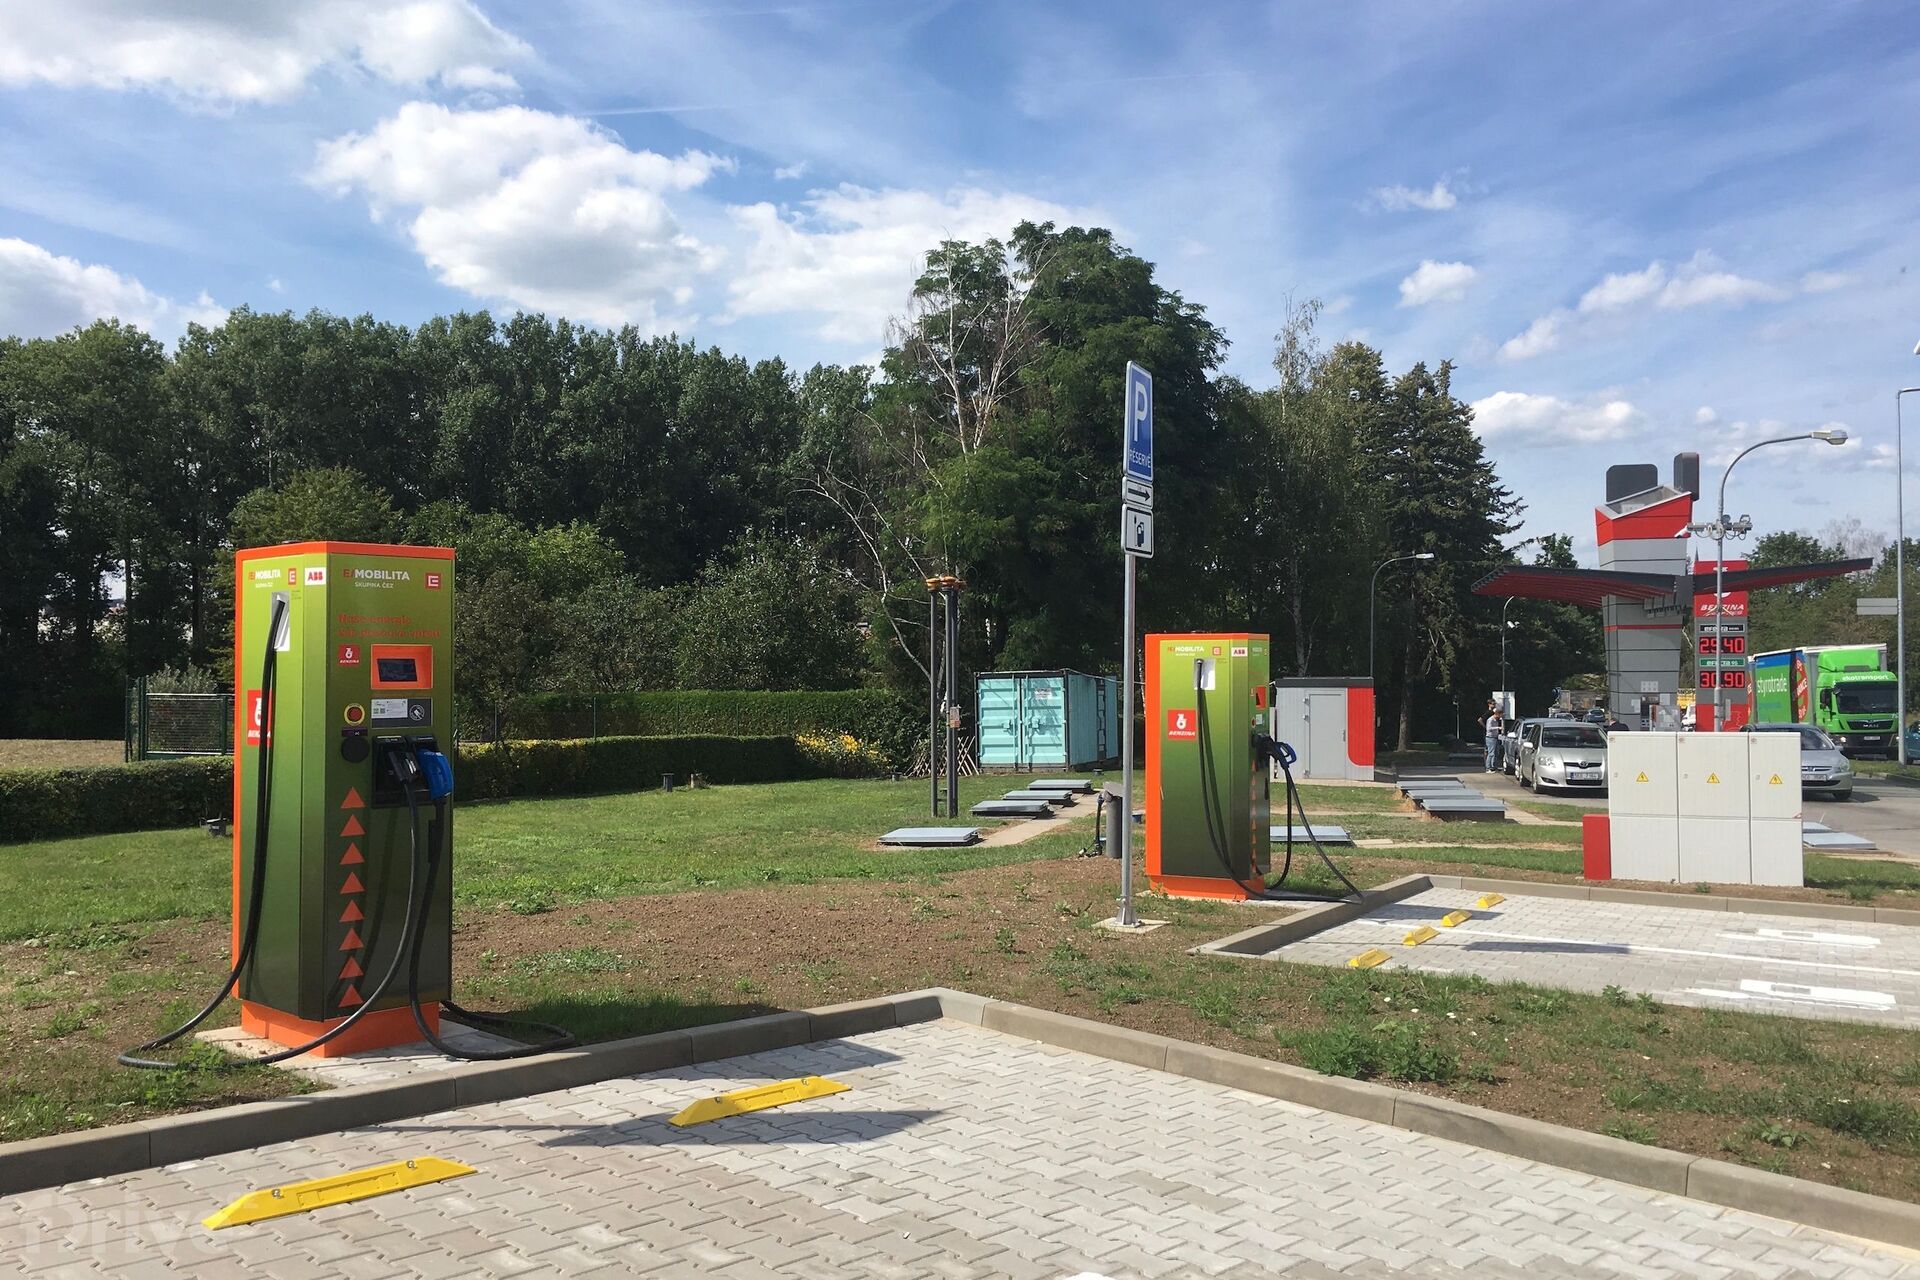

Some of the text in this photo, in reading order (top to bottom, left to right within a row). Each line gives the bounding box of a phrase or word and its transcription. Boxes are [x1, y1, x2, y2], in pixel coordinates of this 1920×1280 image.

[1133, 380, 1147, 442] P
[308, 571, 323, 581] ABB
[1757, 673, 1787, 697] styrotrade
[1842, 674, 1889, 682] ekotransport
